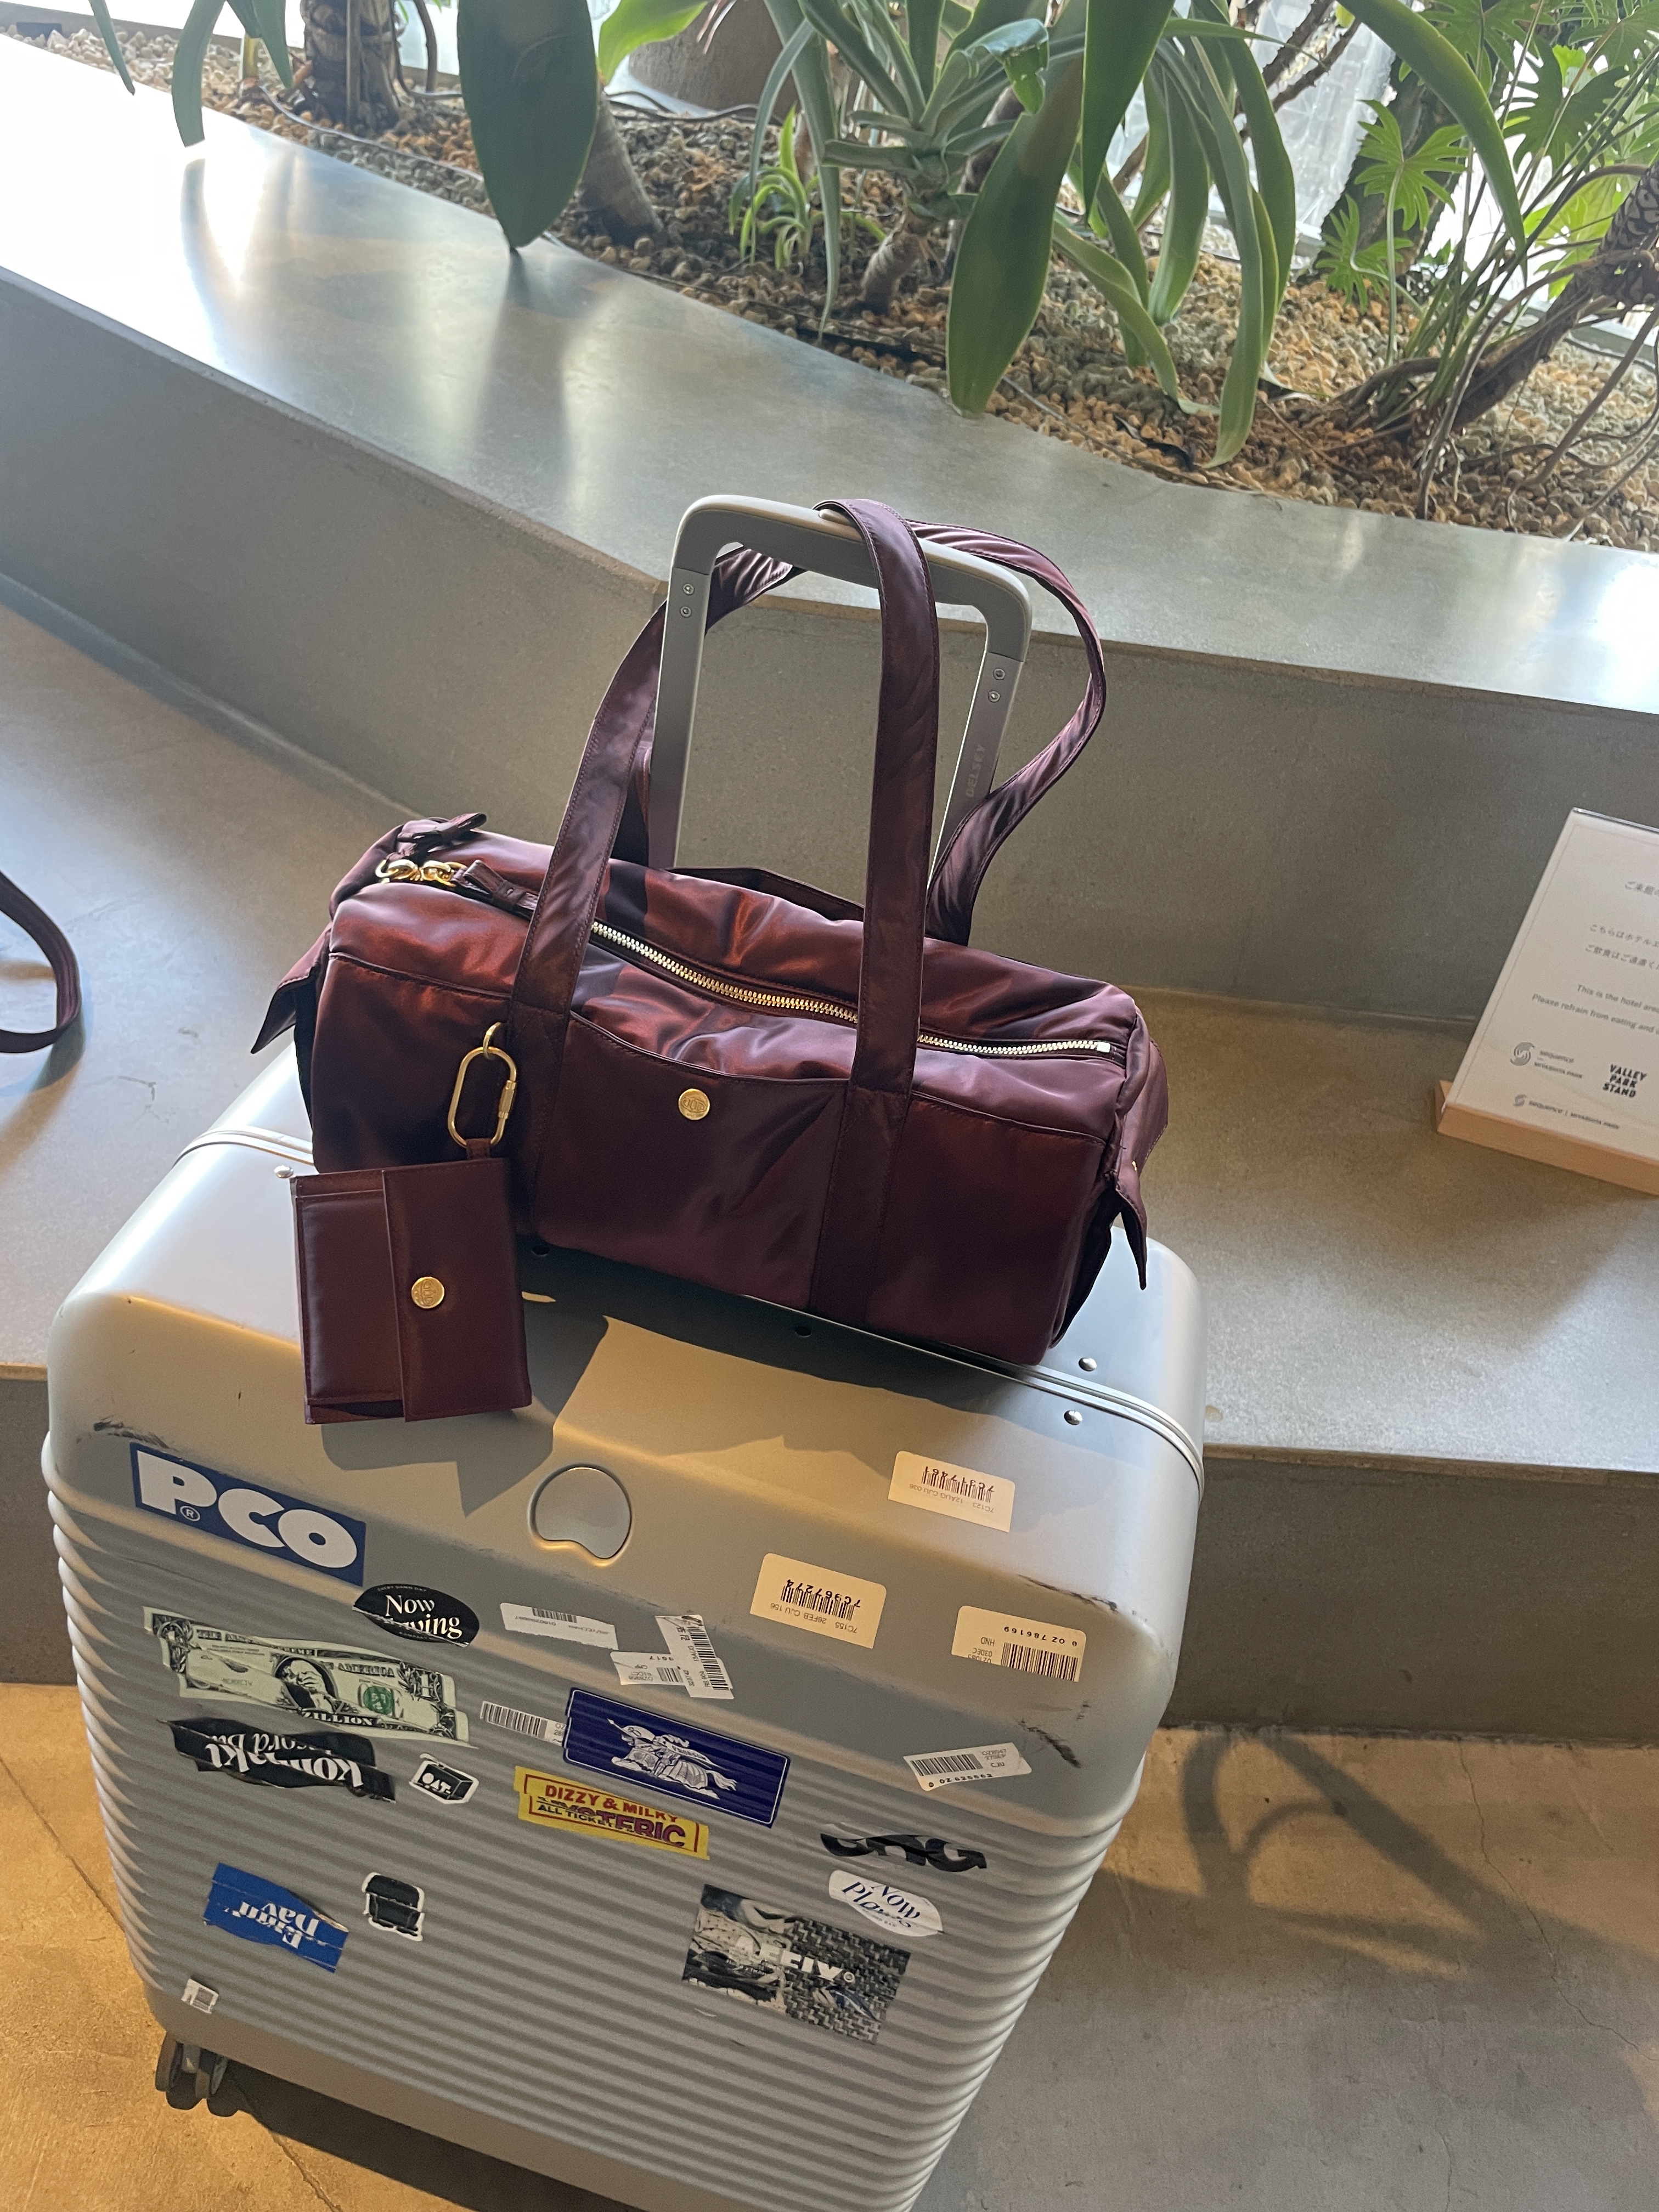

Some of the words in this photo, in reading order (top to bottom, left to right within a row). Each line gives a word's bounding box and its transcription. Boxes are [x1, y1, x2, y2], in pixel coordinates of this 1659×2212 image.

[1577, 984, 1594, 996] This
[1605, 993, 1618, 1001] the
[1621, 996, 1642, 1008] hotel
[1532, 993, 1559, 1007] Please
[1561, 1003, 1588, 1015] refrain
[1590, 1009, 1609, 1020] from
[1611, 1017, 1637, 1029] eating
[1638, 1024, 1655, 1033] and
[1610, 1063, 1647, 1081] VALLEY
[1610, 1074, 1637, 1088] PARK
[1602, 1082, 1636, 1098] STAND
[924, 1488, 938, 1497] CJU
[940, 1493, 963, 1504] 12AUG
[972, 1503, 995, 1513] 7C123
[787, 1579, 861, 1607] 7C967274
[385, 1595, 435, 1617] Now
[770, 1603, 783, 1611] 156
[785, 1607, 800, 1616] CJU
[804, 1613, 827, 1623] 26FEB
[835, 1622, 857, 1633] 7C155
[1004, 1627, 1047, 1641] 786169
[981, 1637, 996, 1646] HND
[972, 1647, 993, 1657] 03DEC
[303, 1712, 374, 1726] ZILLION
[537, 1804, 562, 1815] ALL
[545, 1785, 600, 1807] DIZZY
[603, 1798, 619, 1810] &
[623, 1801, 678, 1822] MILKY
